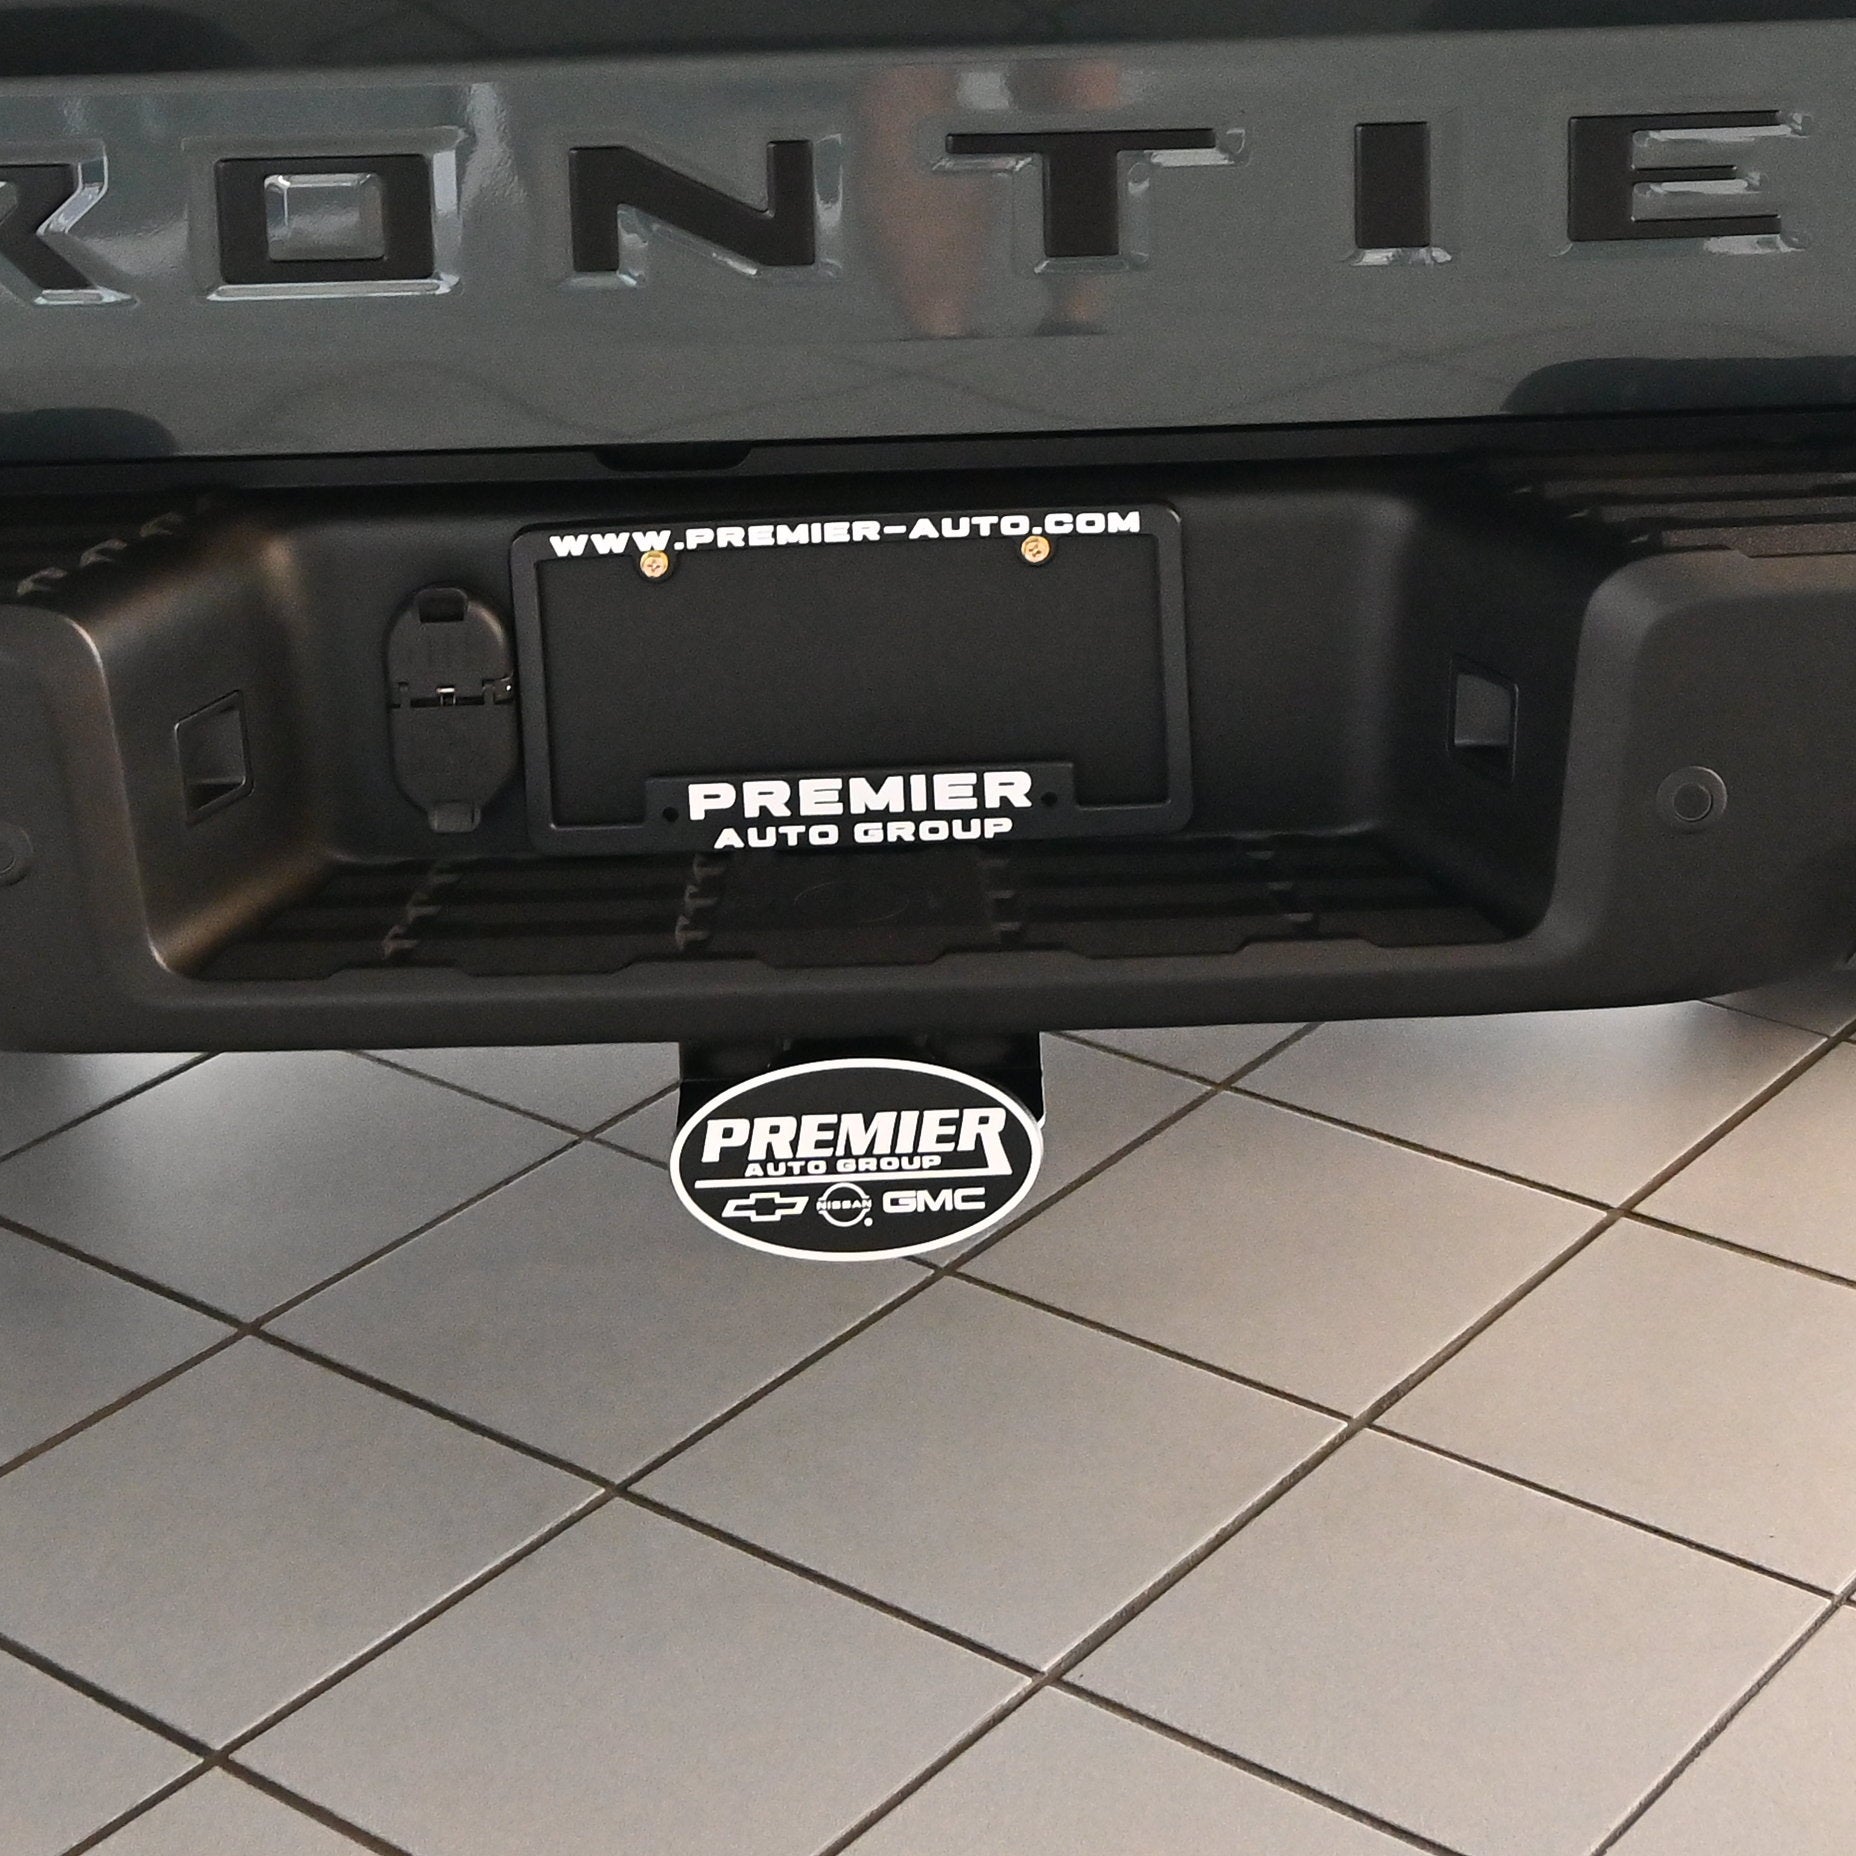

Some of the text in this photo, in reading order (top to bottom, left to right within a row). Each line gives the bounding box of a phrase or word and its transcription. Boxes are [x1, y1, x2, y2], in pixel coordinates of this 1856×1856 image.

[549, 510, 1142, 558] WWW.PREMIER-AUTO.COM
[686, 769, 1034, 822] PREMIER
[713, 816, 1014, 850] AUTO GROUP
[700, 1106, 1010, 1167] PREMIER
[744, 1154, 943, 1178] AUTO GROUP
[815, 1186, 986, 1213] NISSAN GMC
